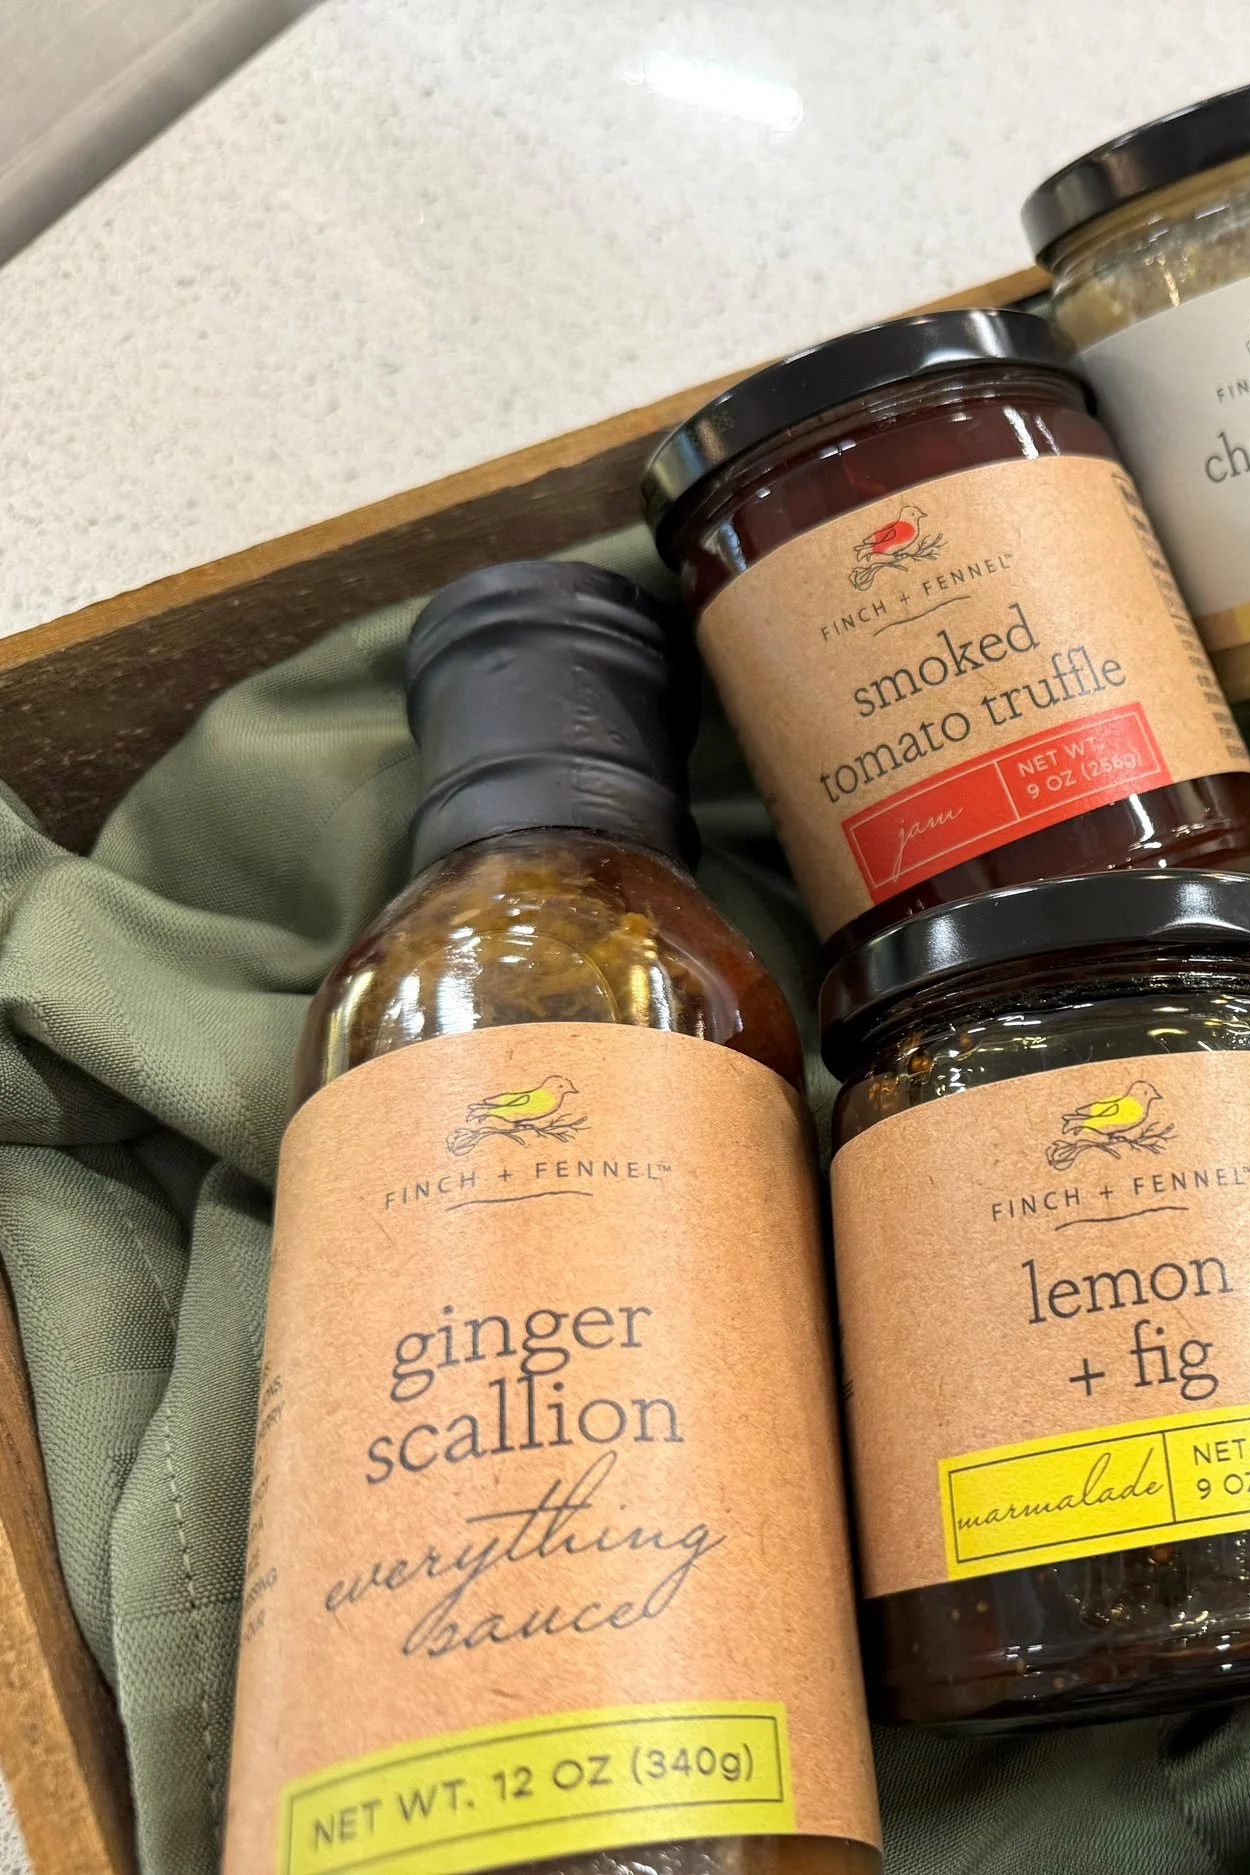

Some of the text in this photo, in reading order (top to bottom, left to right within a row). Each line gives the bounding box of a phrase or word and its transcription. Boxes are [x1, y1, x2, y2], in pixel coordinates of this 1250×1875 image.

[820, 600, 888, 642] FINCH
[853, 603, 1039, 718] smoked
[818, 646, 1128, 805] tomato truffle
[1018, 736, 1106, 778] NET WT.
[1027, 784, 1041, 801] 9
[1047, 770, 1078, 792] OZ
[892, 805, 963, 882] jam
[383, 1171, 478, 1211] FINCH
[991, 1186, 1081, 1222] FINCH
[1021, 1254, 1234, 1325] lemon
[389, 1304, 653, 1401] ginger
[1068, 1318, 1220, 1401] + fig
[365, 1374, 684, 1486] scallion
[1192, 1440, 1249, 1466] NET
[955, 1449, 1164, 1533] marmalade
[1197, 1478, 1211, 1500] 9
[323, 1450, 728, 1655] everything
[425, 1603, 650, 1658] sauce
[313, 1743, 754, 1847] NET WT. 12 OZ (340g)
